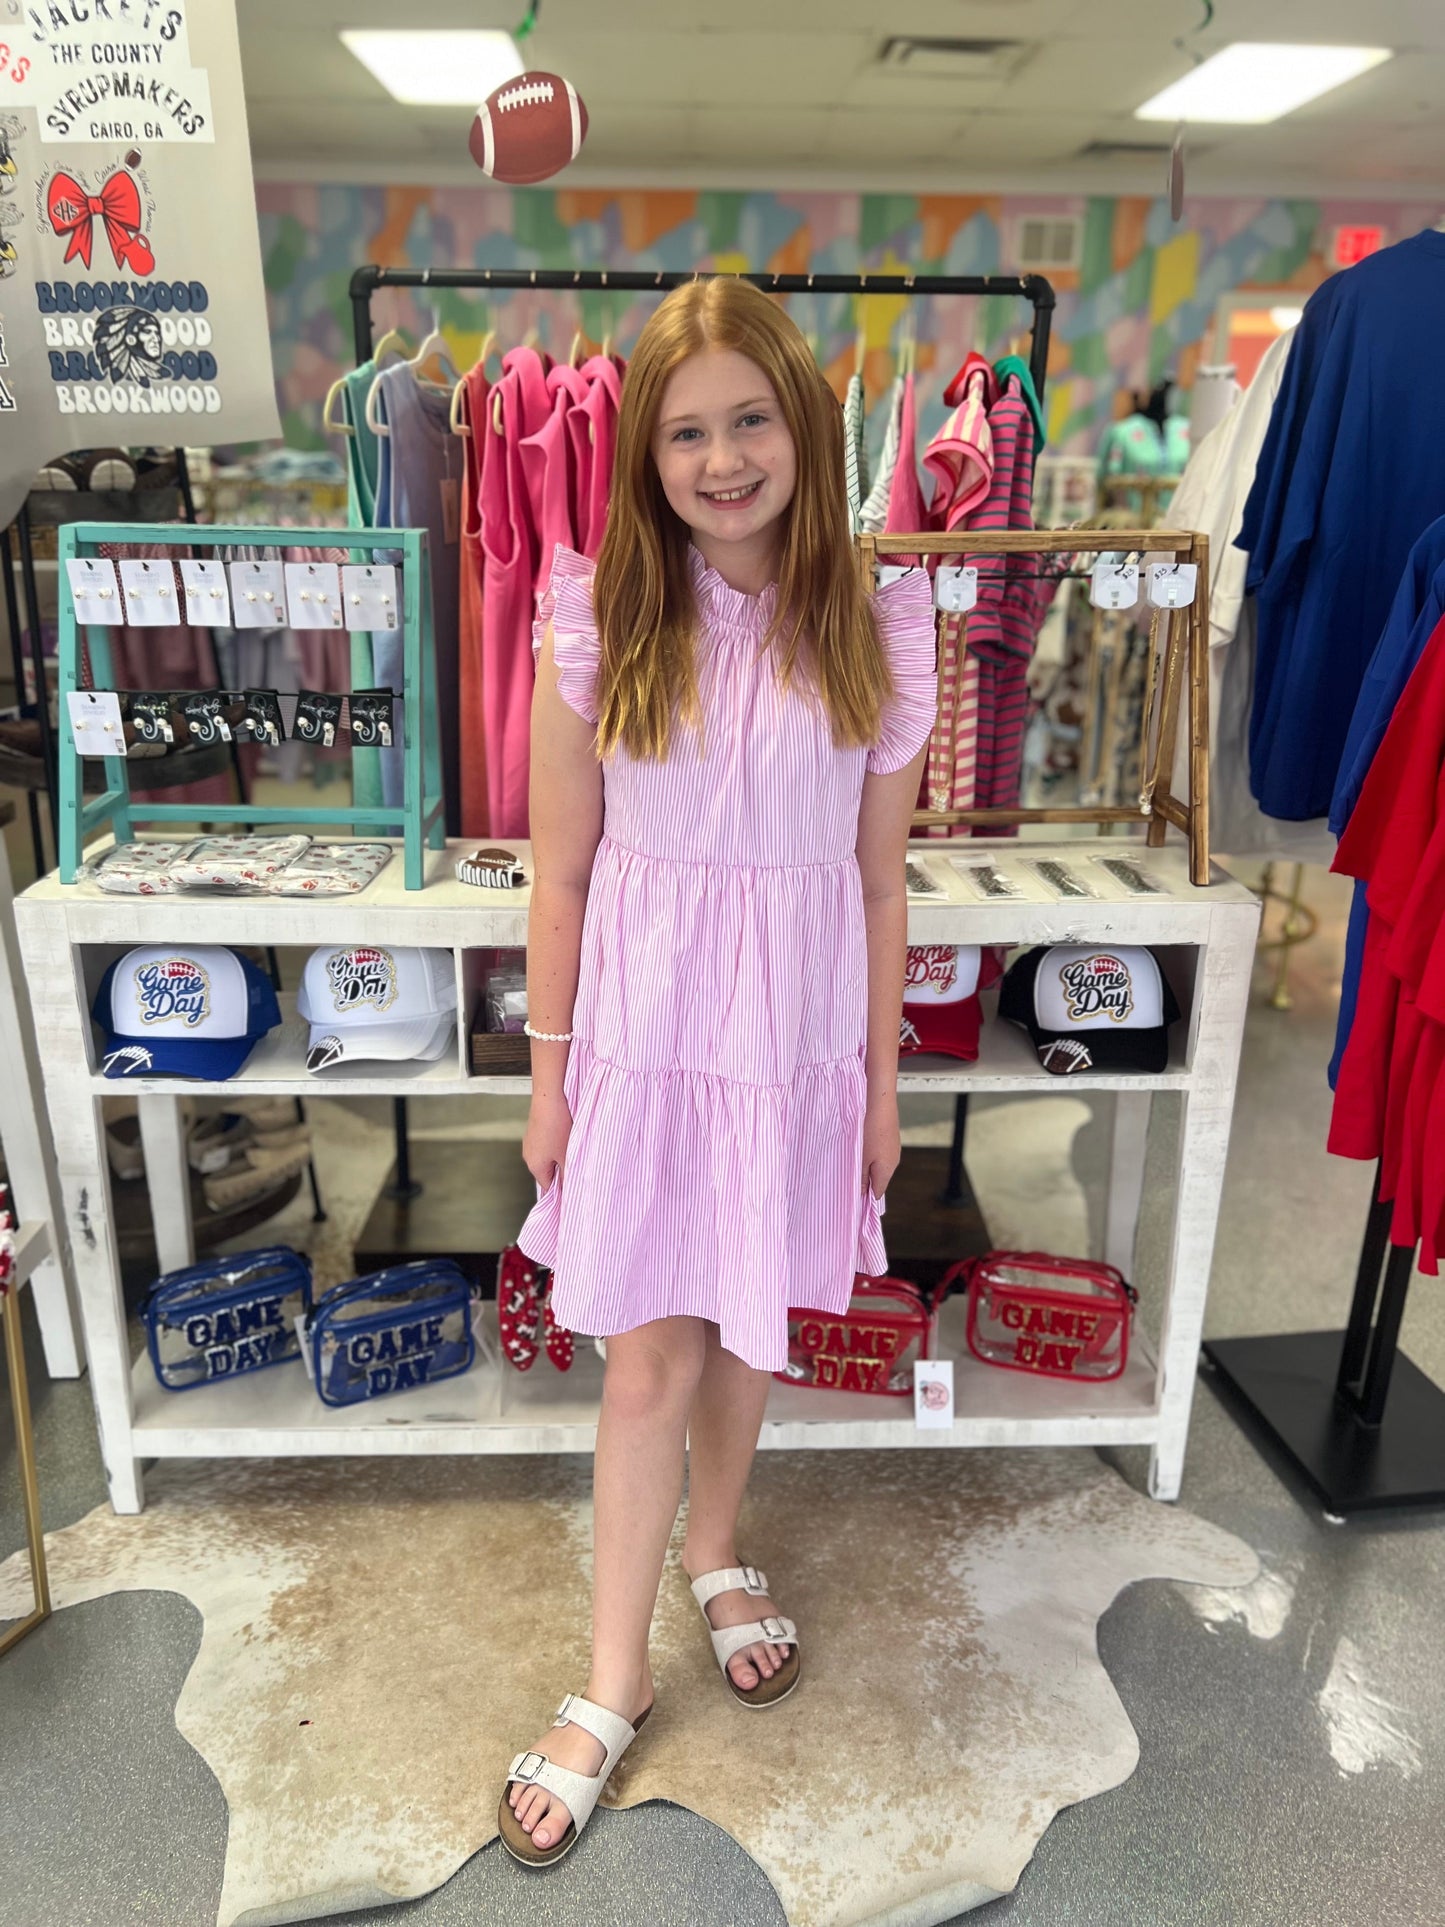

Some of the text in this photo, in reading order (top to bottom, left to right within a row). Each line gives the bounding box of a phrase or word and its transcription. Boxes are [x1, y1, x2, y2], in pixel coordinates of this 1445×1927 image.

[50, 43, 162, 64] THE COUNTY
[46, 71, 205, 136] SYRUPMAKERS
[90, 121, 163, 139] CAIRO, GA
[35, 281, 209, 313] BROOKWOOD
[42, 317, 212, 347] BROOOD
[55, 385, 222, 414] BROOKWOOD
[138, 965, 205, 1001] Game
[329, 954, 391, 989] Game
[904, 959, 955, 991] Day
[1064, 964, 1128, 998] Game
[144, 990, 206, 1024] Day
[337, 977, 392, 1007] Day
[1072, 987, 1130, 1017] Day
[182, 1296, 284, 1348] GAME
[1000, 1300, 1101, 1342] GAME
[204, 1332, 273, 1379] DAY
[347, 1315, 446, 1368] GAME
[798, 1319, 899, 1360] GAME
[1013, 1336, 1085, 1373] DAY
[366, 1349, 436, 1397] DAY
[812, 1353, 886, 1392] DAY
